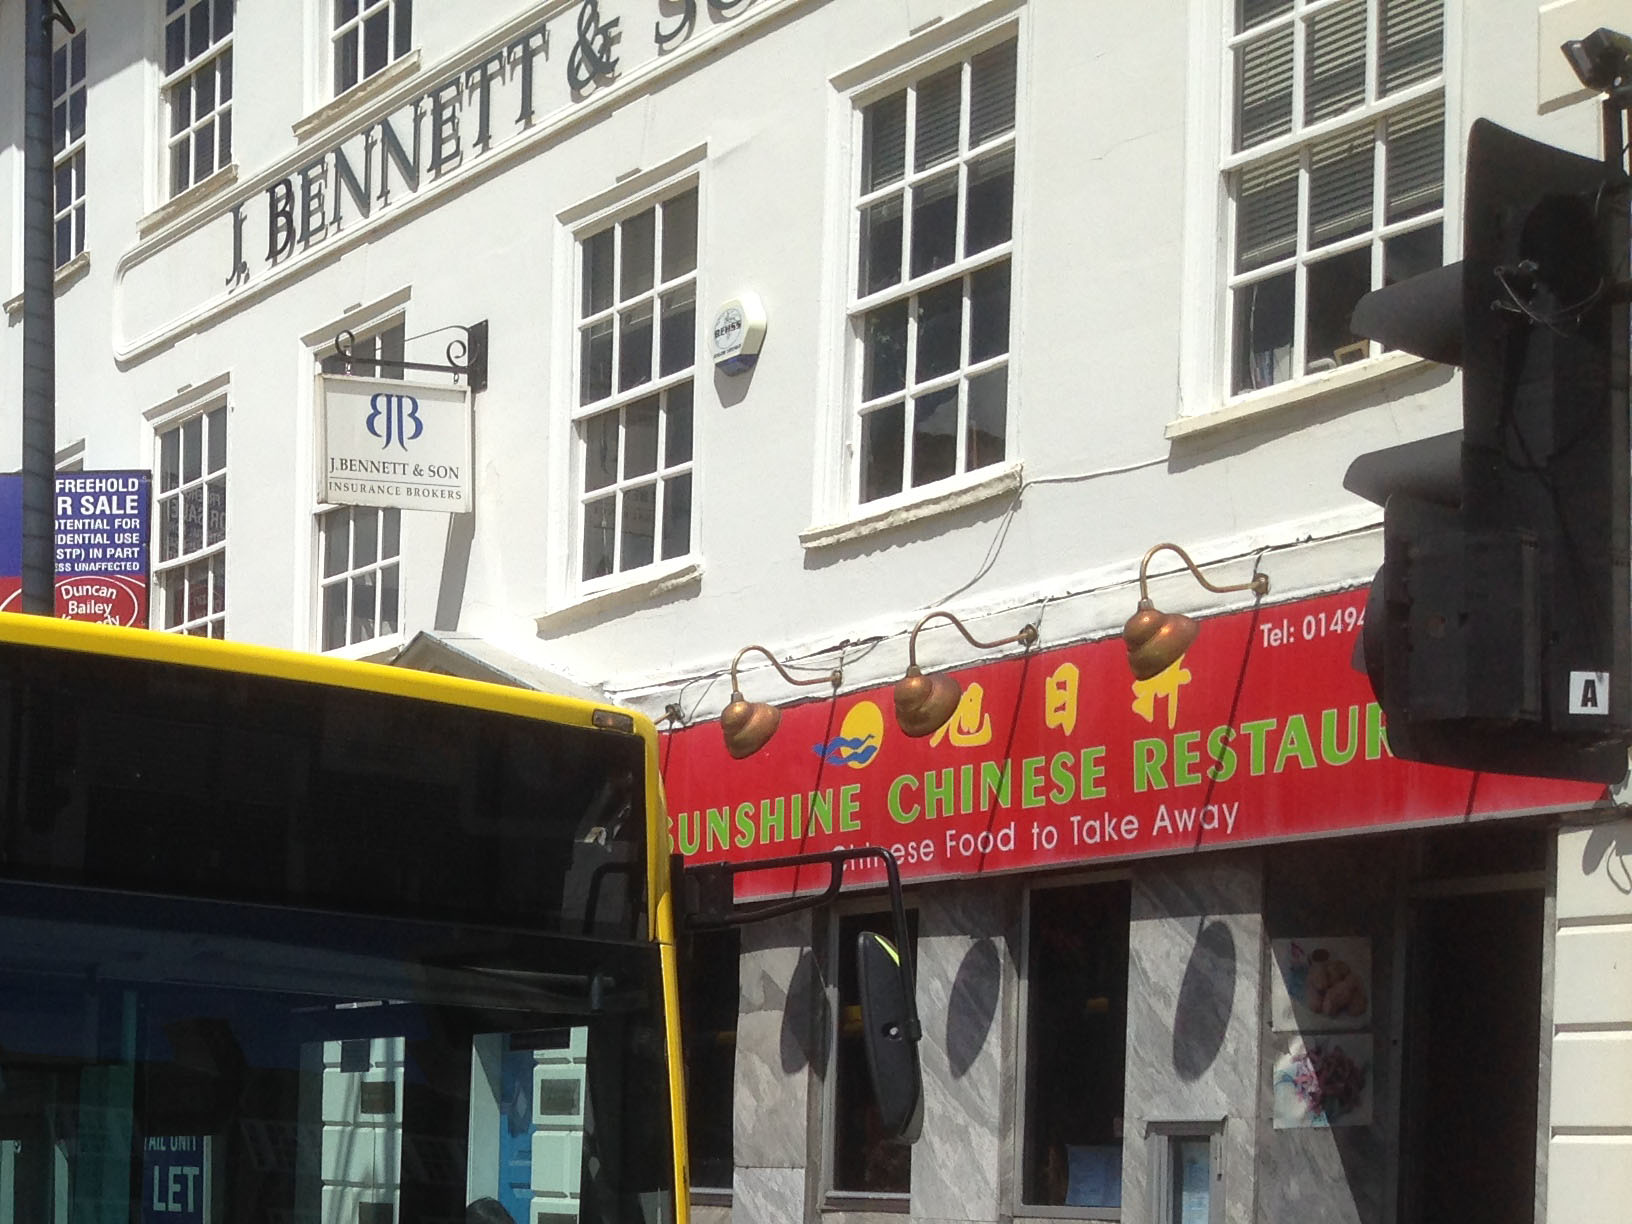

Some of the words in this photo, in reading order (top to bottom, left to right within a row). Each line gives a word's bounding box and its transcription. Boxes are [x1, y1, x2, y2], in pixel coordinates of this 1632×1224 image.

[265, 23, 548, 263] BENNETT
[412, 463, 425, 477] &
[428, 464, 460, 480] SON
[55, 478, 139, 493] FREEHOLD
[329, 481, 401, 496] INSURANCE
[406, 487, 462, 500] BROKERS
[80, 494, 139, 515] SALE
[55, 519, 111, 530] TENTIAL
[114, 518, 140, 529] FOR
[55, 533, 111, 545] IDENTIAL
[114, 533, 140, 544] USE
[56, 548, 85, 562] STP)
[89, 548, 103, 559] IN
[106, 547, 140, 559] PART
[74, 561, 140, 572] UNAFFECTED
[61, 585, 117, 600] Duncan
[68, 600, 113, 617] Bailey
[1260, 618, 1295, 648] Tel:
[1581, 679, 1599, 708] A
[887, 745, 1107, 825] CHINESE
[1133, 702, 1395, 793] RESTAUR
[945, 821, 1016, 858] Food
[1032, 821, 1058, 851] to
[1070, 811, 1139, 845] Take
[1152, 801, 1239, 836] Away
[153, 1165, 199, 1213] LET
